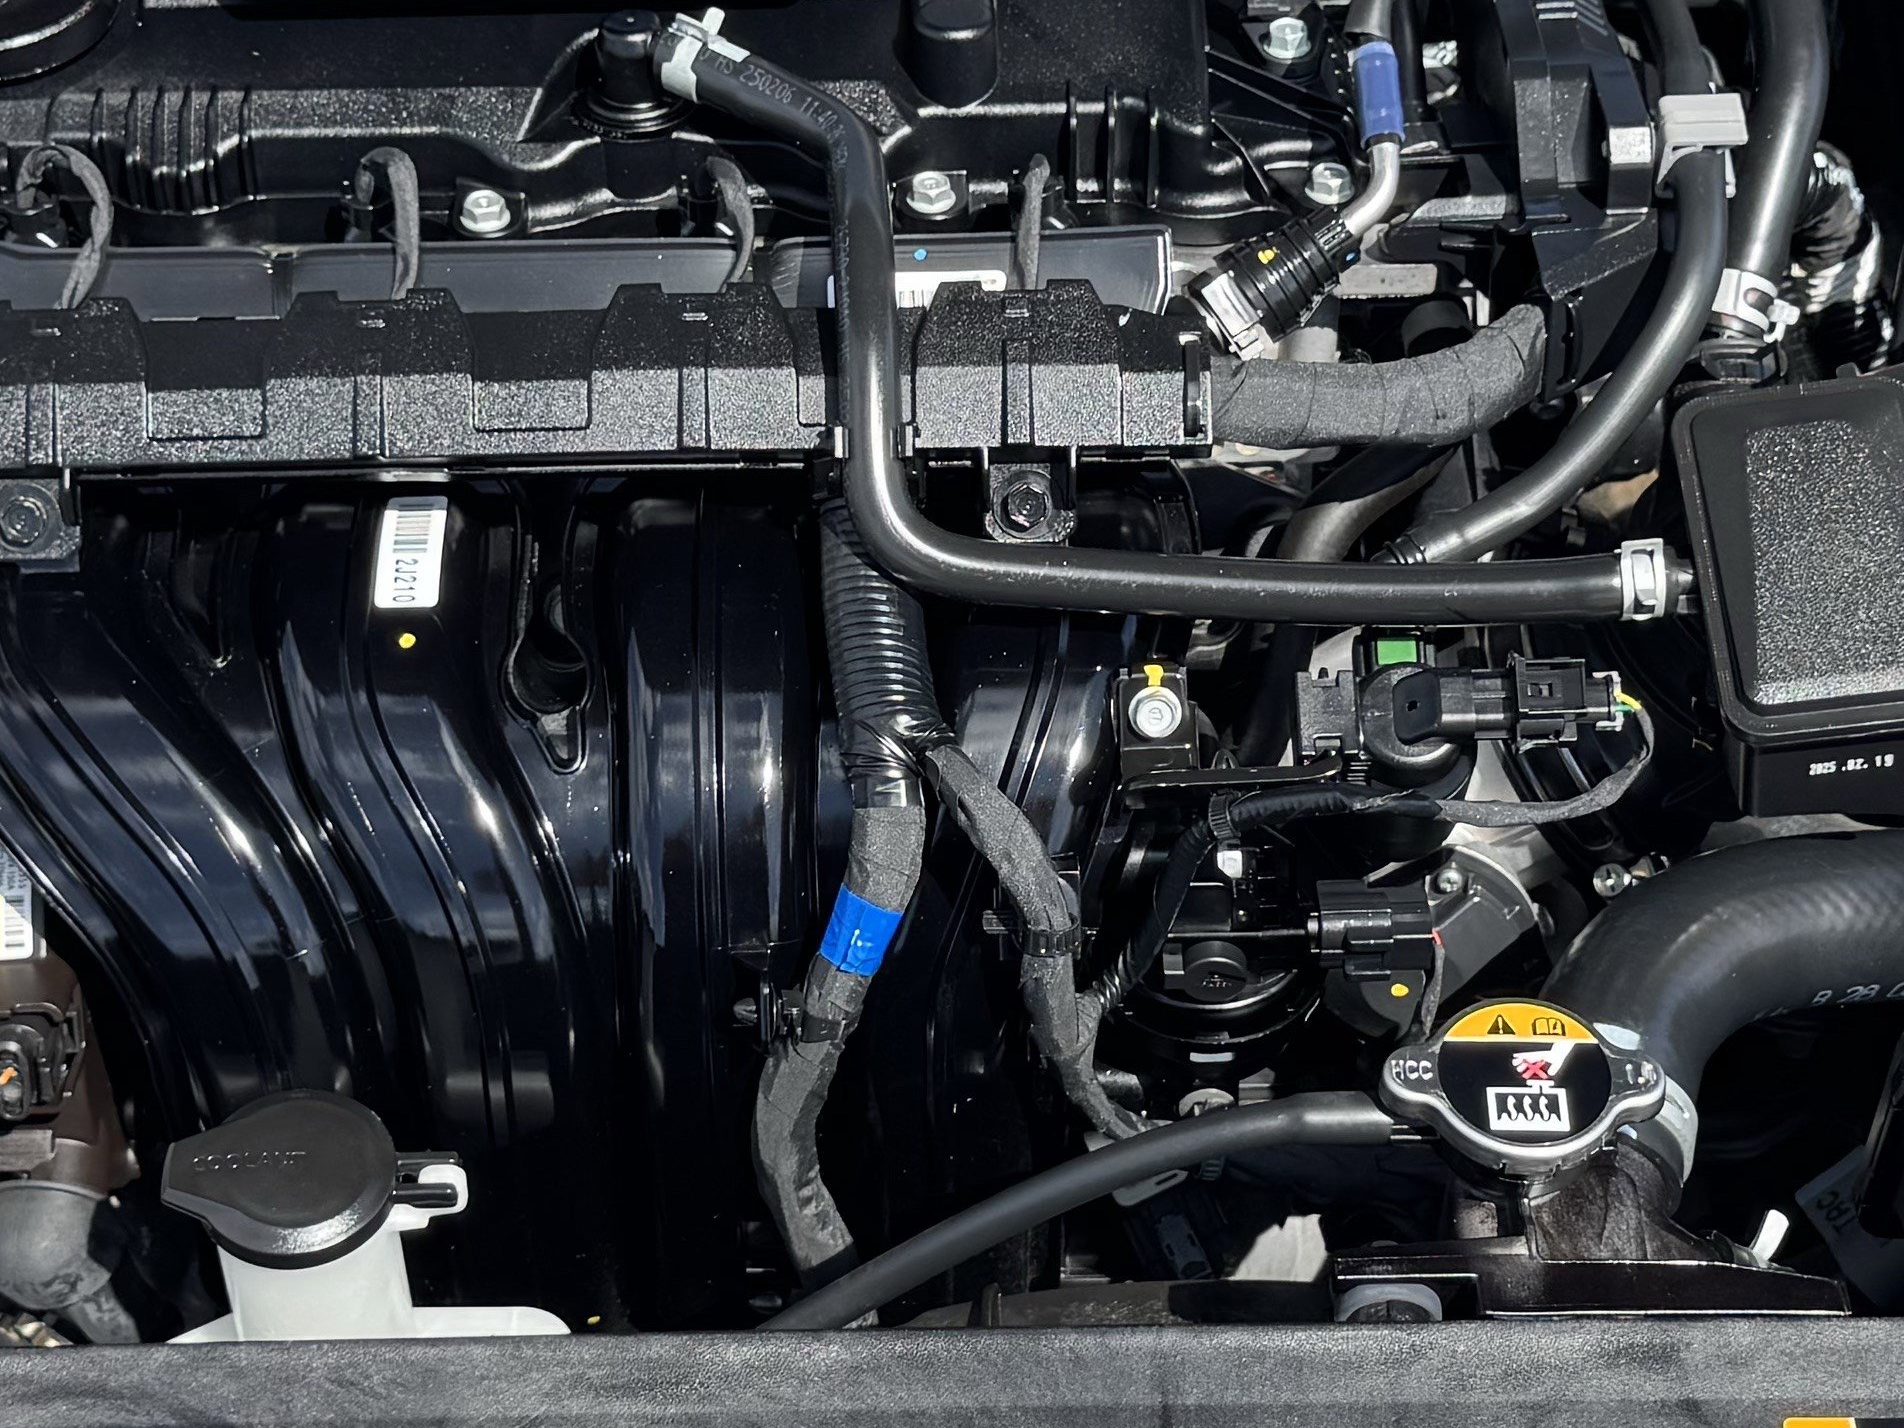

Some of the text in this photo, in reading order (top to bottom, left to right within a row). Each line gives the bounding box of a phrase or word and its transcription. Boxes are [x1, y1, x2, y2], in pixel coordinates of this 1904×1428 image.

[739, 64, 795, 104] 250206
[392, 558, 419, 603] 2J210
[1390, 1059, 1434, 1082] HCC
[192, 1150, 307, 1172] COOLANT
